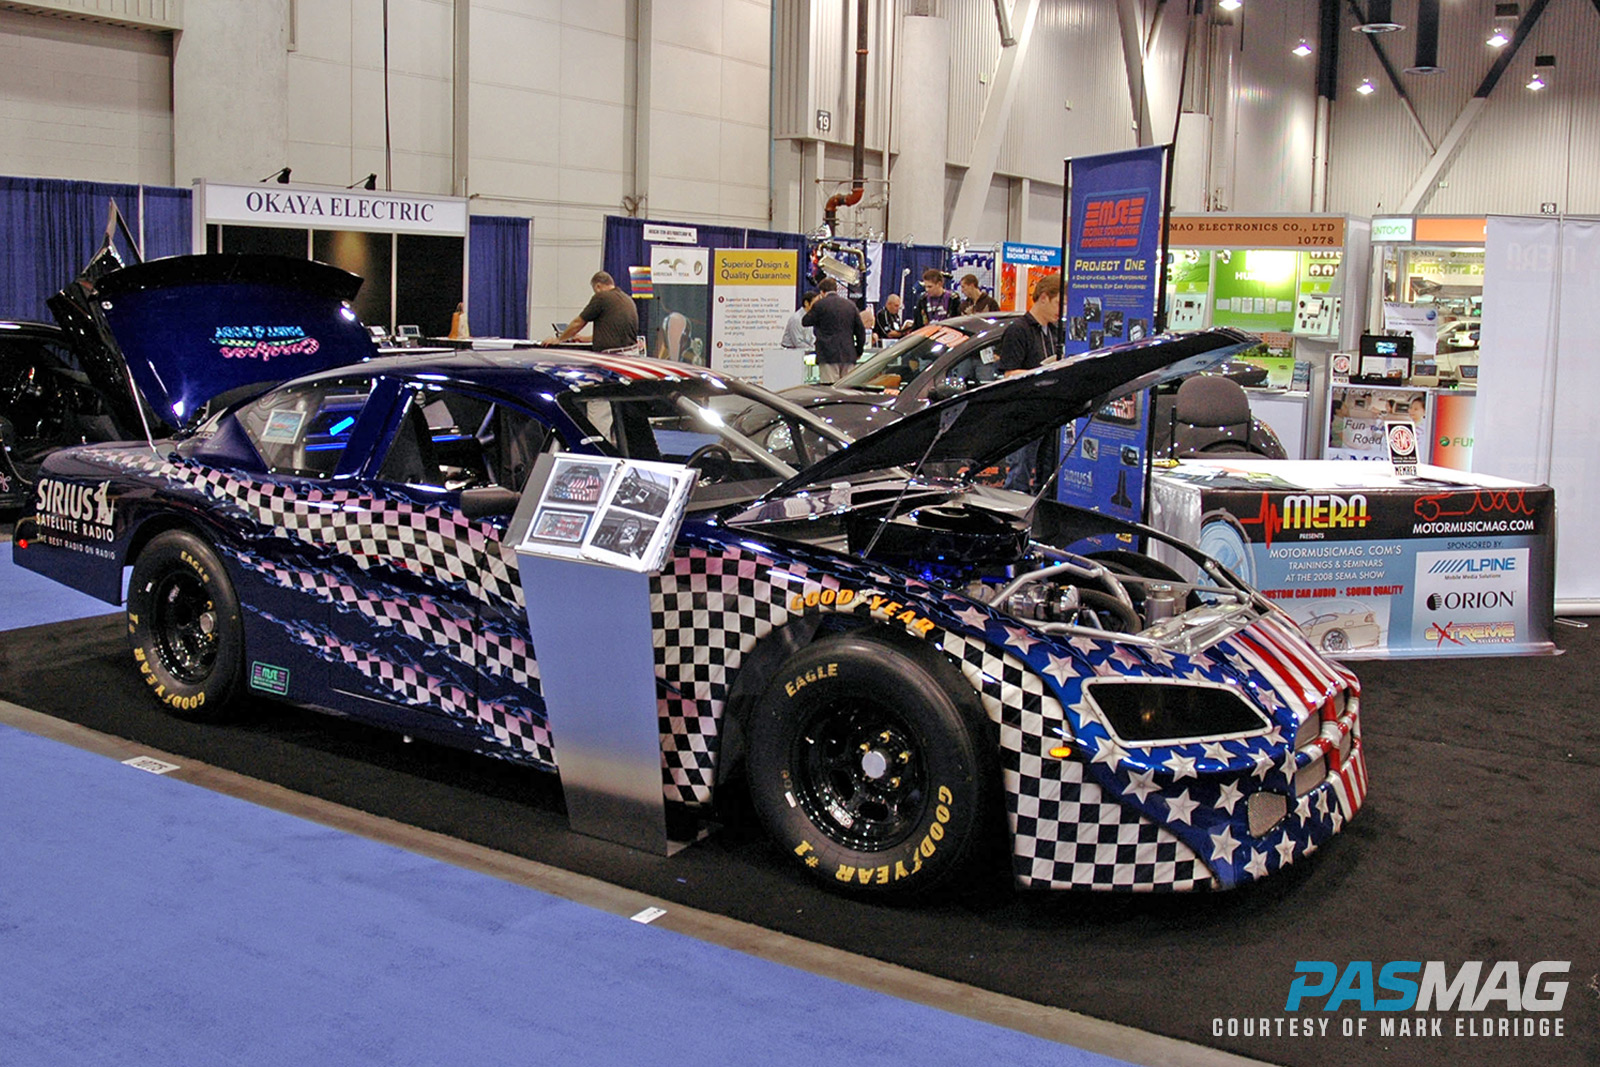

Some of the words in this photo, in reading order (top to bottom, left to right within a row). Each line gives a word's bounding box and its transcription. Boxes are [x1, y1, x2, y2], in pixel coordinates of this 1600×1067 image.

[819, 116, 830, 130] 19
[246, 192, 324, 215] OKAYA
[330, 198, 434, 222] ELECTRIC
[1543, 204, 1555, 213] 18
[1199, 223, 1278, 232] ELECTRONICS
[1283, 223, 1308, 233] CO.,
[1312, 223, 1336, 232] LTD
[1298, 236, 1334, 245] 10778
[721, 258, 754, 270] Superior
[755, 258, 782, 270] Design
[784, 261, 790, 269] &
[1074, 260, 1120, 272] PROJECT
[1124, 258, 1146, 271] ONE
[1415, 264, 1466, 275] FunStar
[721, 269, 750, 281] Quality
[751, 269, 791, 280] Guarantee
[1344, 419, 1366, 430] Fun
[1353, 433, 1383, 445] Road
[36, 478, 94, 521] SIRIUS
[1283, 494, 1367, 529] MERA
[36, 512, 78, 534] SATELLITE
[82, 523, 114, 542] RADIO
[1413, 520, 1534, 534] MOTORMUSICMAG.COM
[1299, 532, 1325, 540] PRESENTS
[48, 536, 63, 547] BEST
[64, 540, 83, 552] RADIO
[84, 545, 94, 555] ON
[95, 547, 115, 560] RADIO
[1447, 541, 1492, 549] SPONSORED
[1269, 546, 1366, 559] MOTORMUSICMAG.
[1368, 545, 1402, 556] COM'S
[180, 550, 210, 583] EAGLE
[1289, 560, 1333, 570] TRAININGS
[1335, 561, 1341, 569] &
[1343, 559, 1383, 569] SEMINARS
[1452, 557, 1516, 573] ALPINE
[1285, 573, 1296, 583] AT
[1297, 573, 1312, 582] THE
[1314, 572, 1333, 581] 2008
[1335, 572, 1357, 580] SEMA
[1359, 570, 1385, 579] SHOW
[1296, 588, 1312, 598] CAR
[1312, 587, 1337, 598] AUDIO
[1346, 585, 1372, 596] SOUND
[1373, 585, 1404, 596] QUALITY
[1444, 590, 1514, 609] ORION
[785, 663, 838, 698] EAGLE
